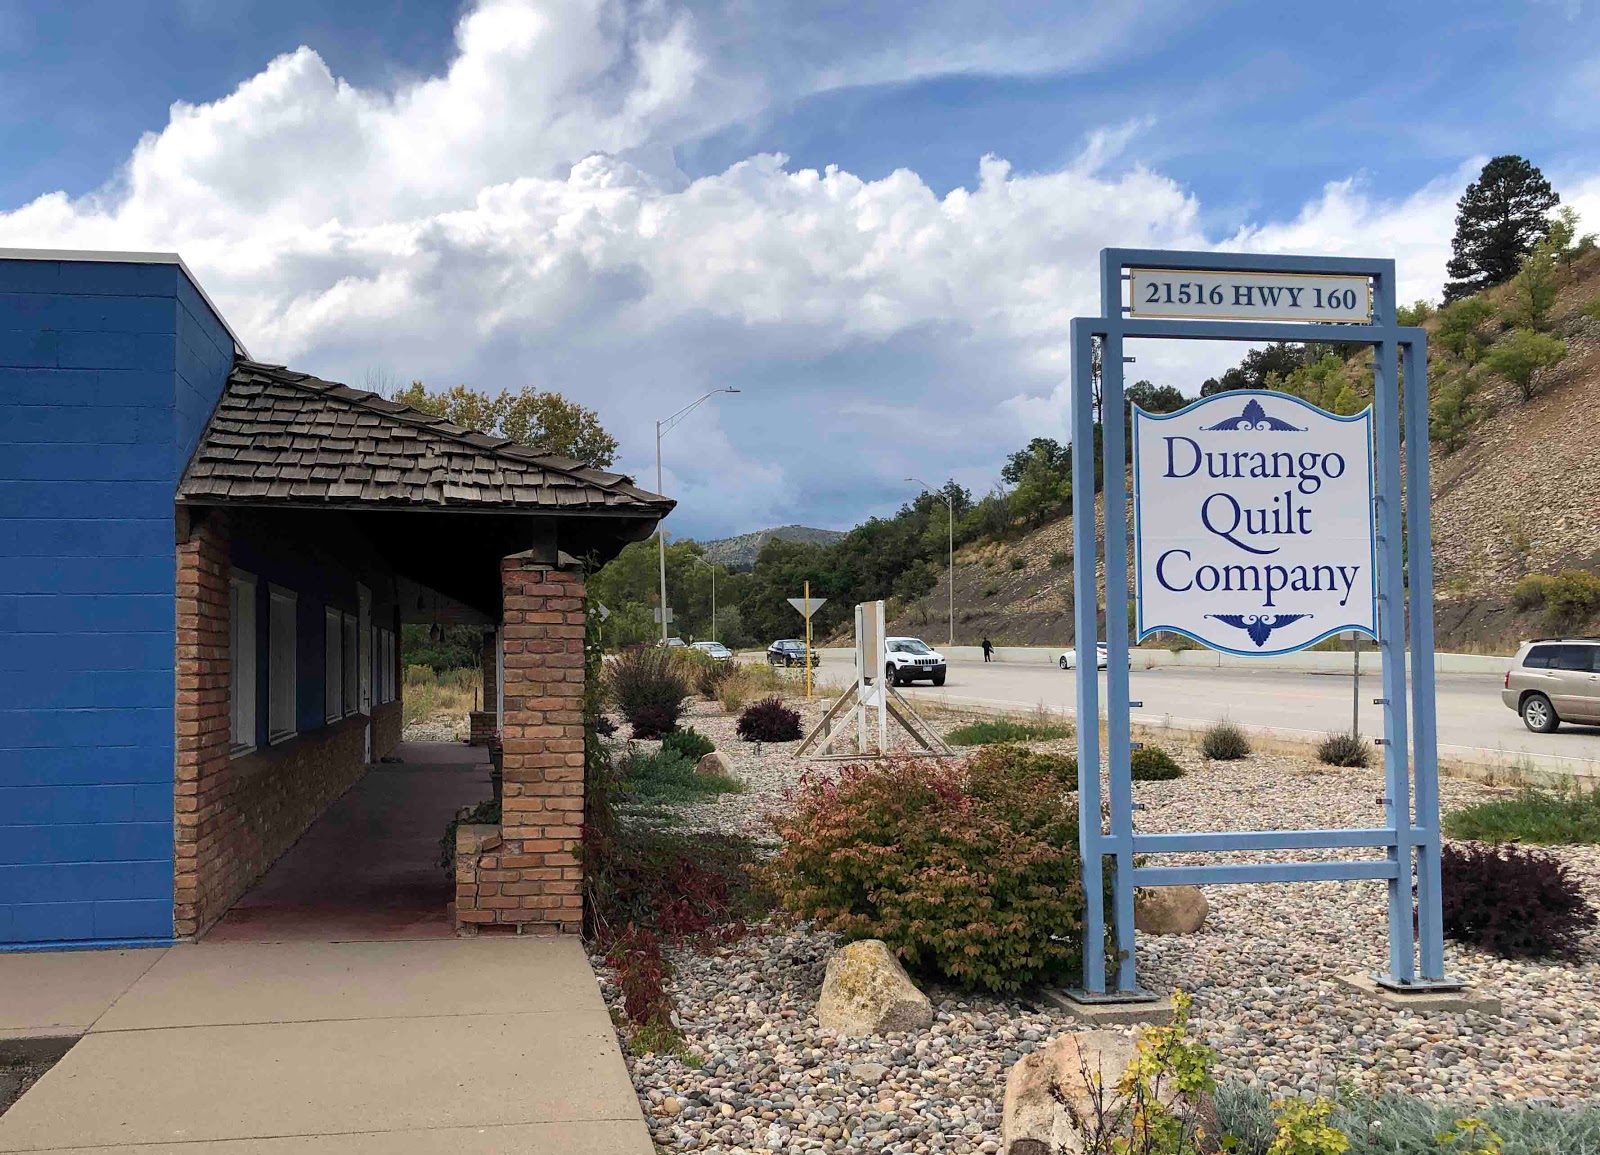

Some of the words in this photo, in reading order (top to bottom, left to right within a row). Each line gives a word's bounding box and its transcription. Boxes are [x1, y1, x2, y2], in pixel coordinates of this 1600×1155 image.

[1145, 282, 1223, 305] 21516
[1232, 285, 1305, 308] HWY
[1313, 288, 1357, 310] 160
[1162, 436, 1345, 494] Durango
[1202, 490, 1312, 555] Quilt
[1156, 549, 1360, 607] Company
